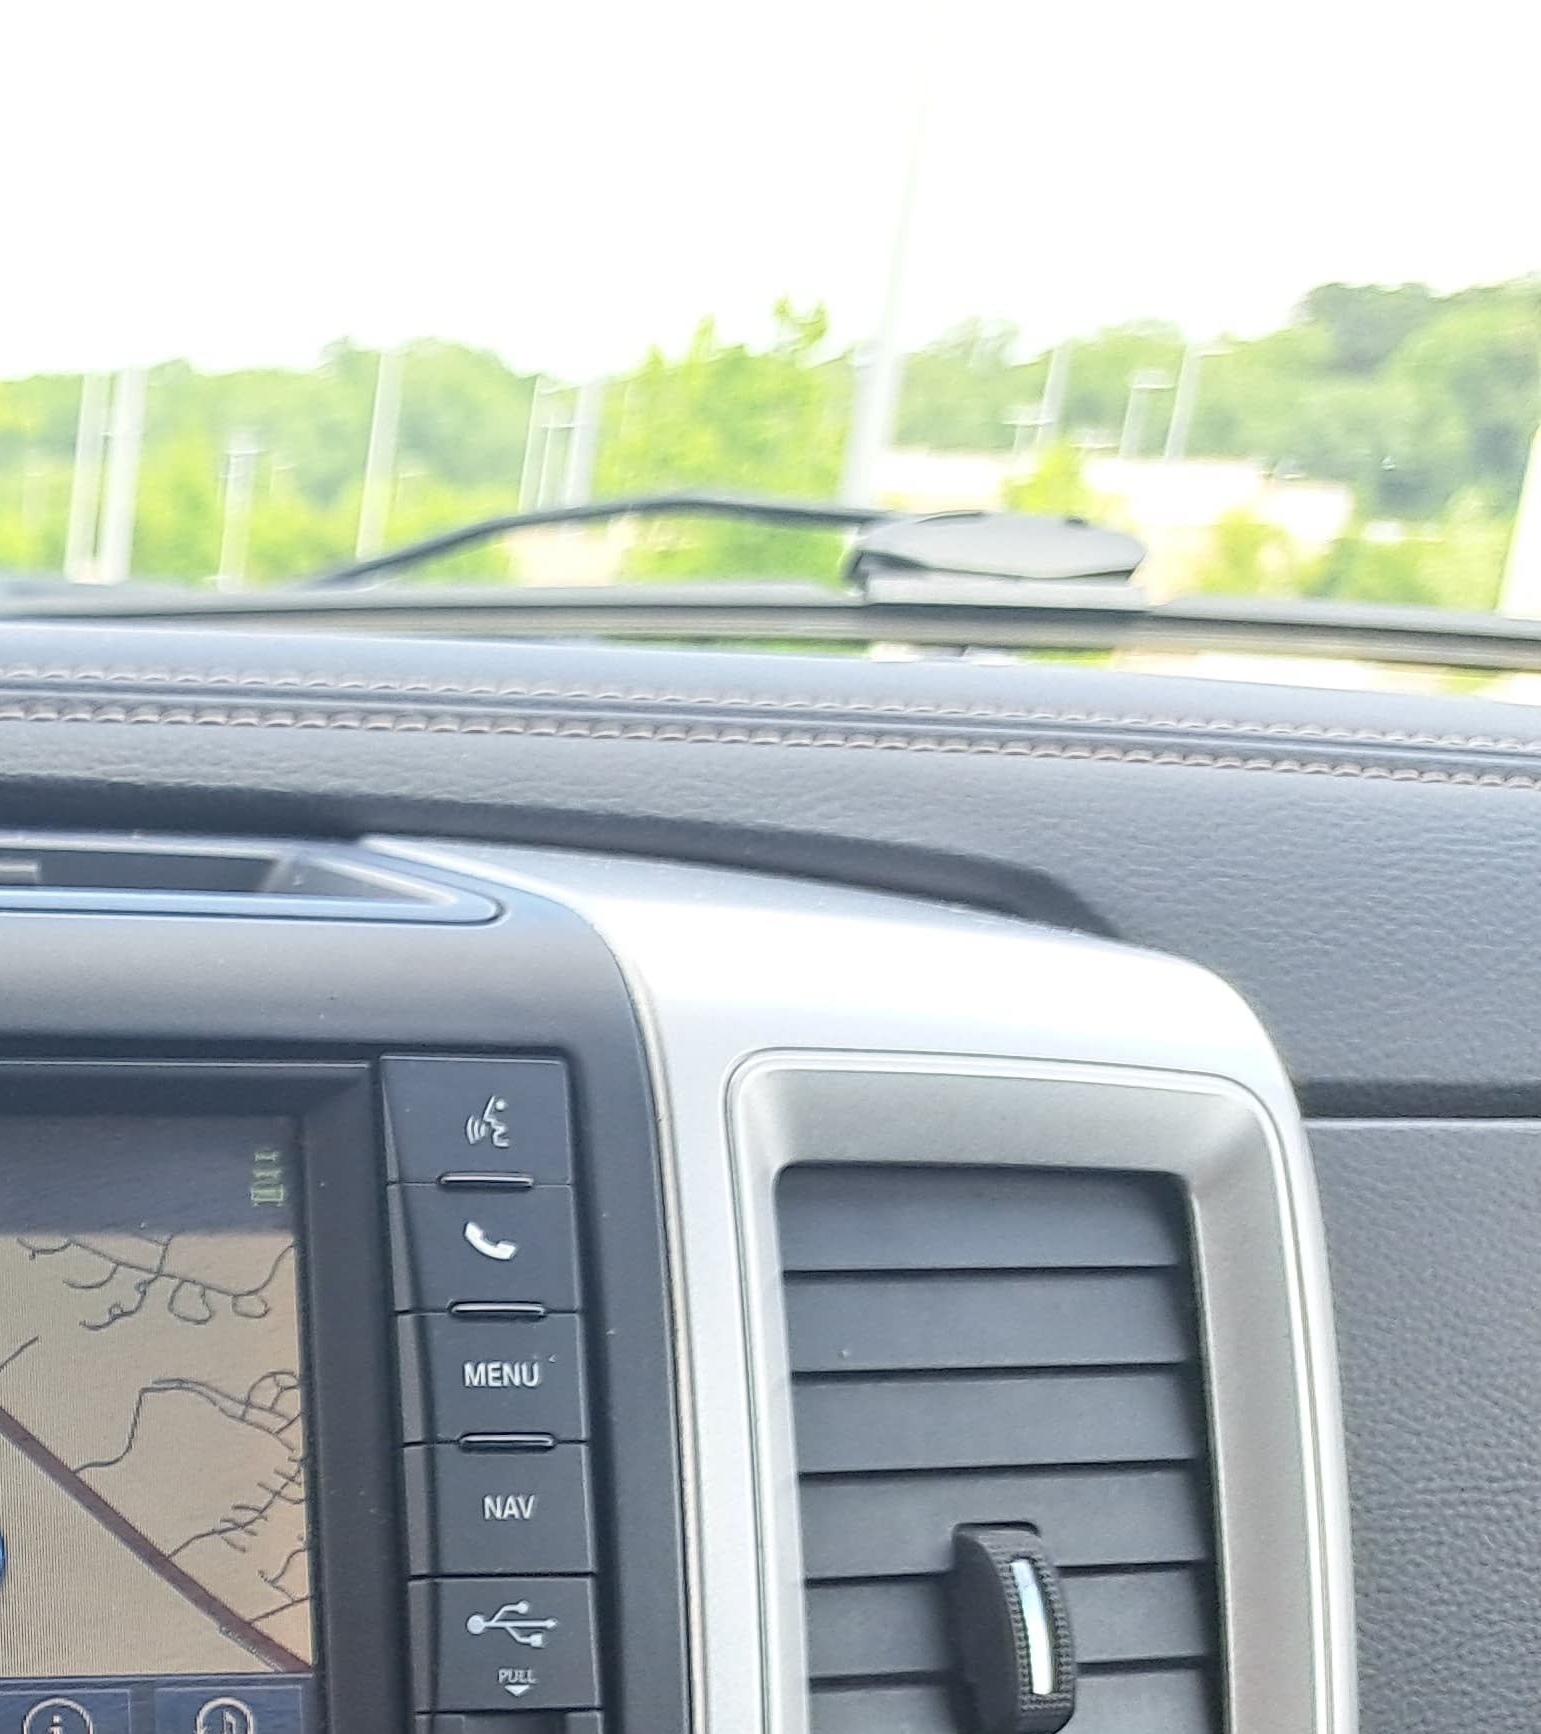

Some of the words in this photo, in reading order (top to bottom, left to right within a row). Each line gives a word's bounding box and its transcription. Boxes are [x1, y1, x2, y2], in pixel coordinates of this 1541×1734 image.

[463, 1361, 542, 1388] MENU
[483, 1494, 536, 1522] NAV
[497, 1667, 538, 1685] PULL
